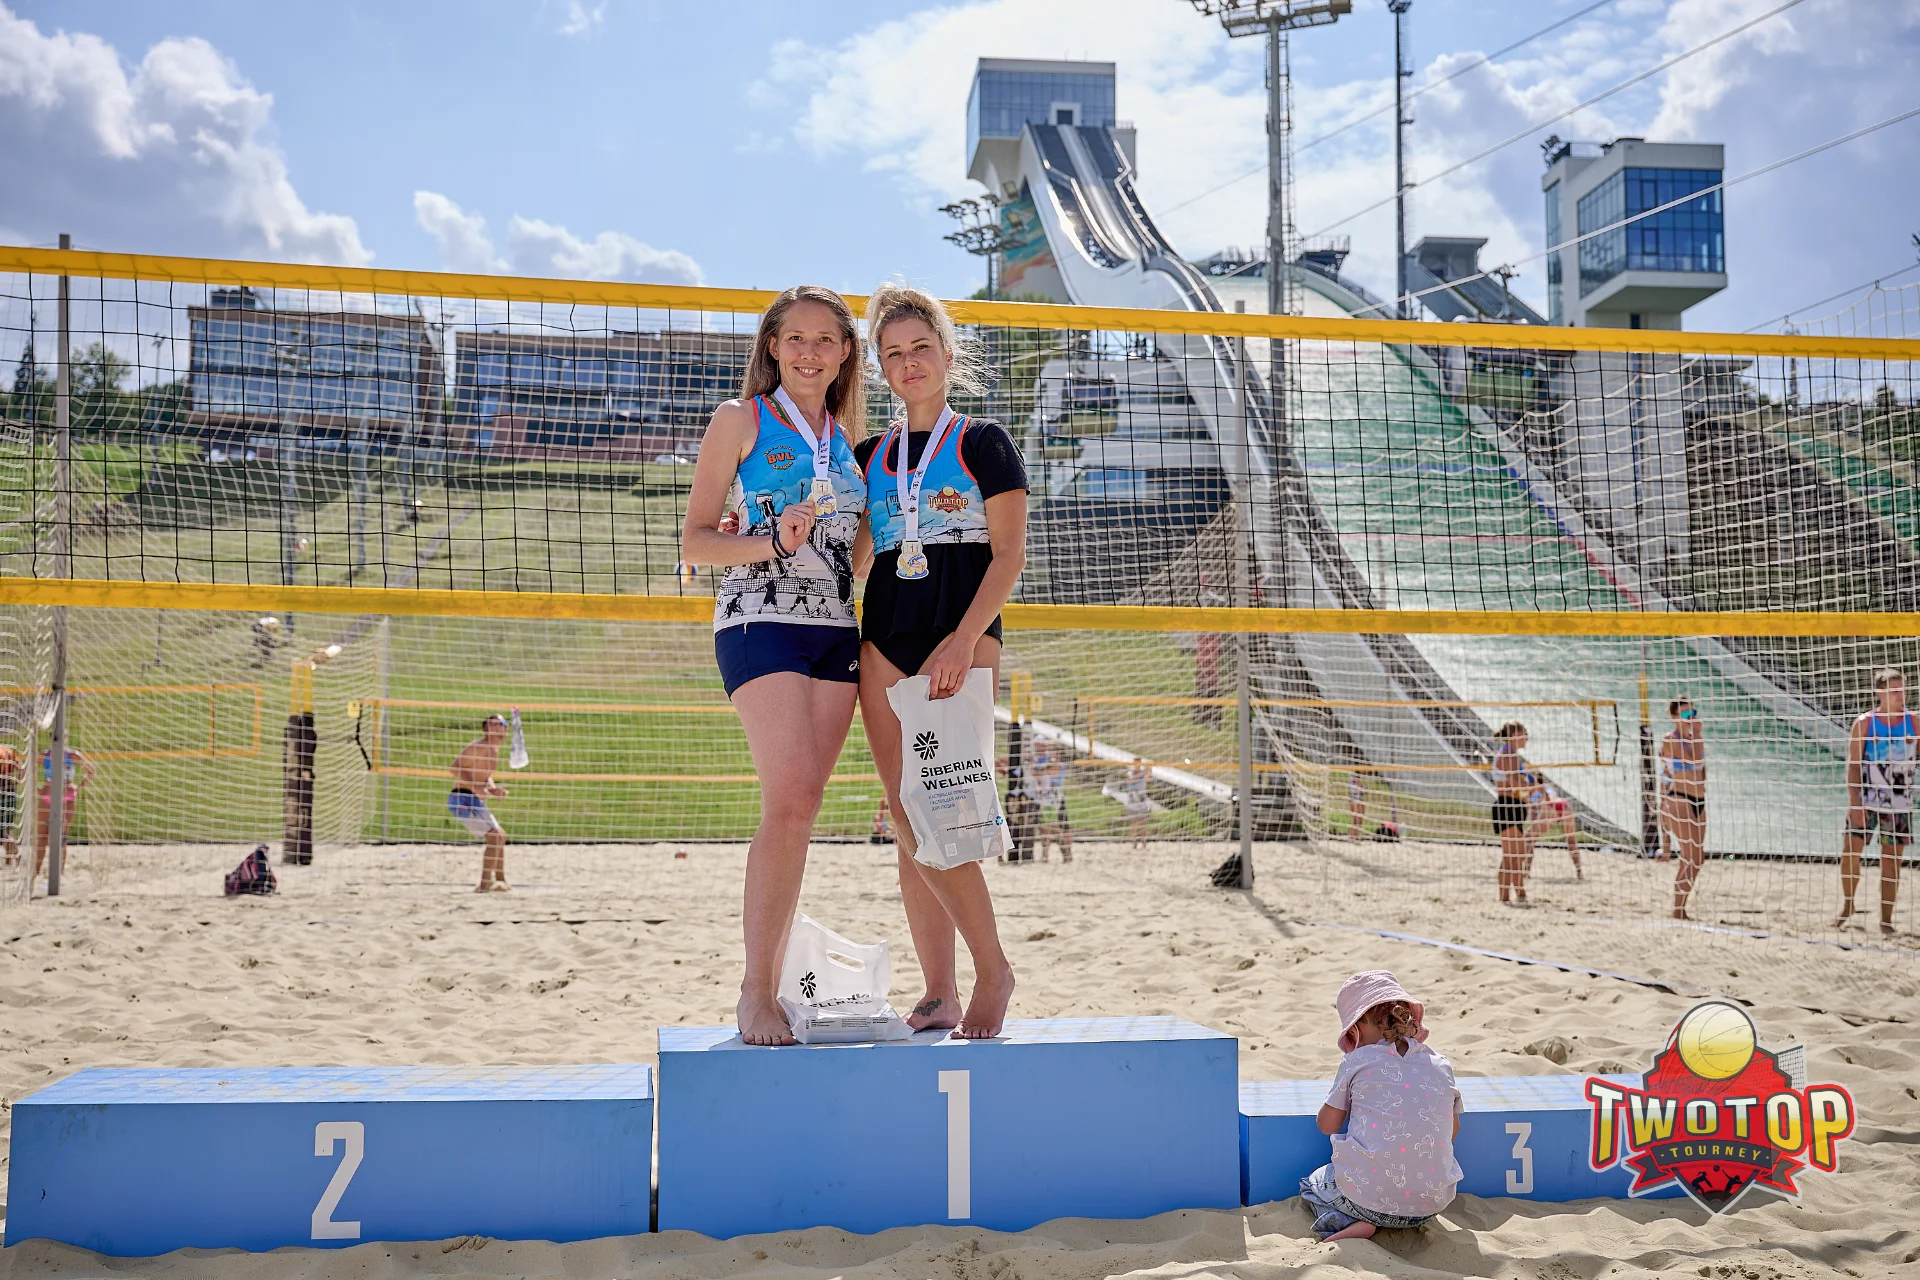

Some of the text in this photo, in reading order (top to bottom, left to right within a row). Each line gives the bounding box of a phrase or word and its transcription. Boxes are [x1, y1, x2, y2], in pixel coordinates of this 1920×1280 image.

[767, 452, 795, 464] BVL
[928, 495, 969, 509] TWOTOP
[920, 758, 983, 778] SIBERIAN
[938, 1070, 970, 1219] 1
[1505, 1122, 1533, 1194] 3
[311, 1121, 364, 1240] 2
